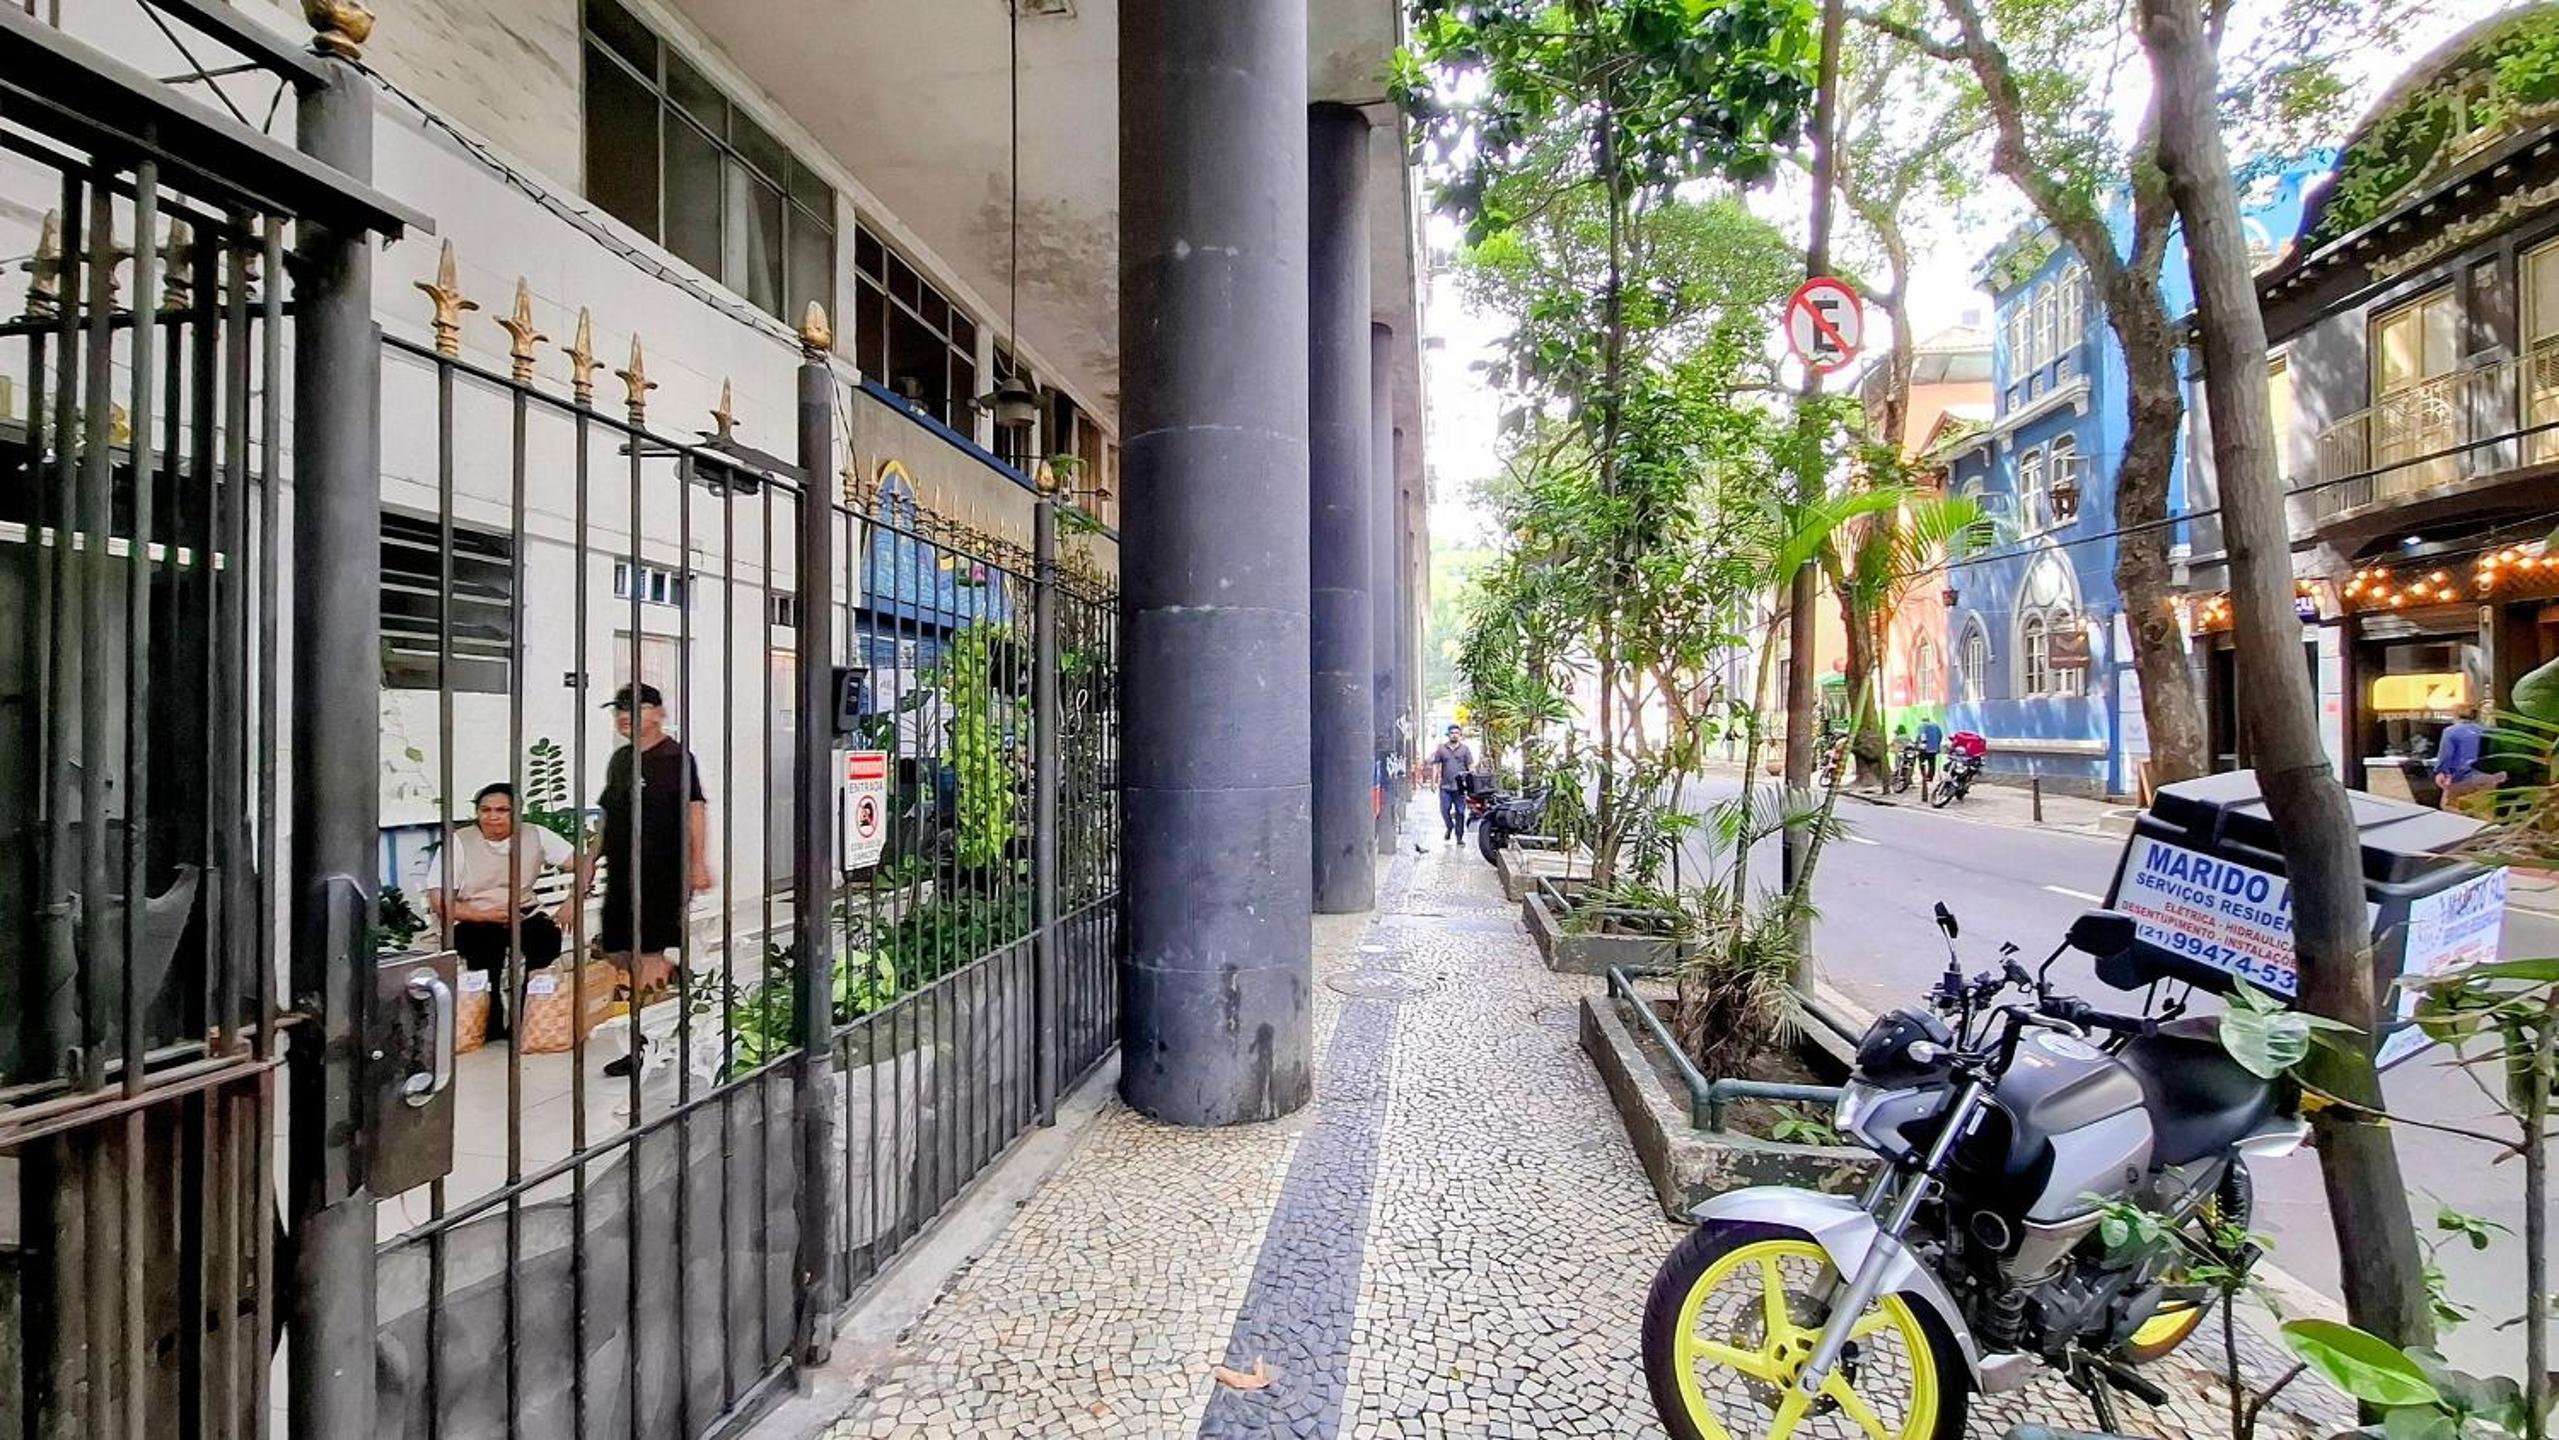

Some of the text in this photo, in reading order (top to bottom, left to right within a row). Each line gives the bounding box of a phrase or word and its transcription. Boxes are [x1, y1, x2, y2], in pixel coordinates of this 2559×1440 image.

[1813, 300, 1839, 352] E
[849, 781, 883, 793] ENTRADA
[2136, 871, 2215, 908] SERVIÇOS
[2146, 844, 2270, 903] MARIDO
[2122, 900, 2216, 940] DESENTUPIMENTO
